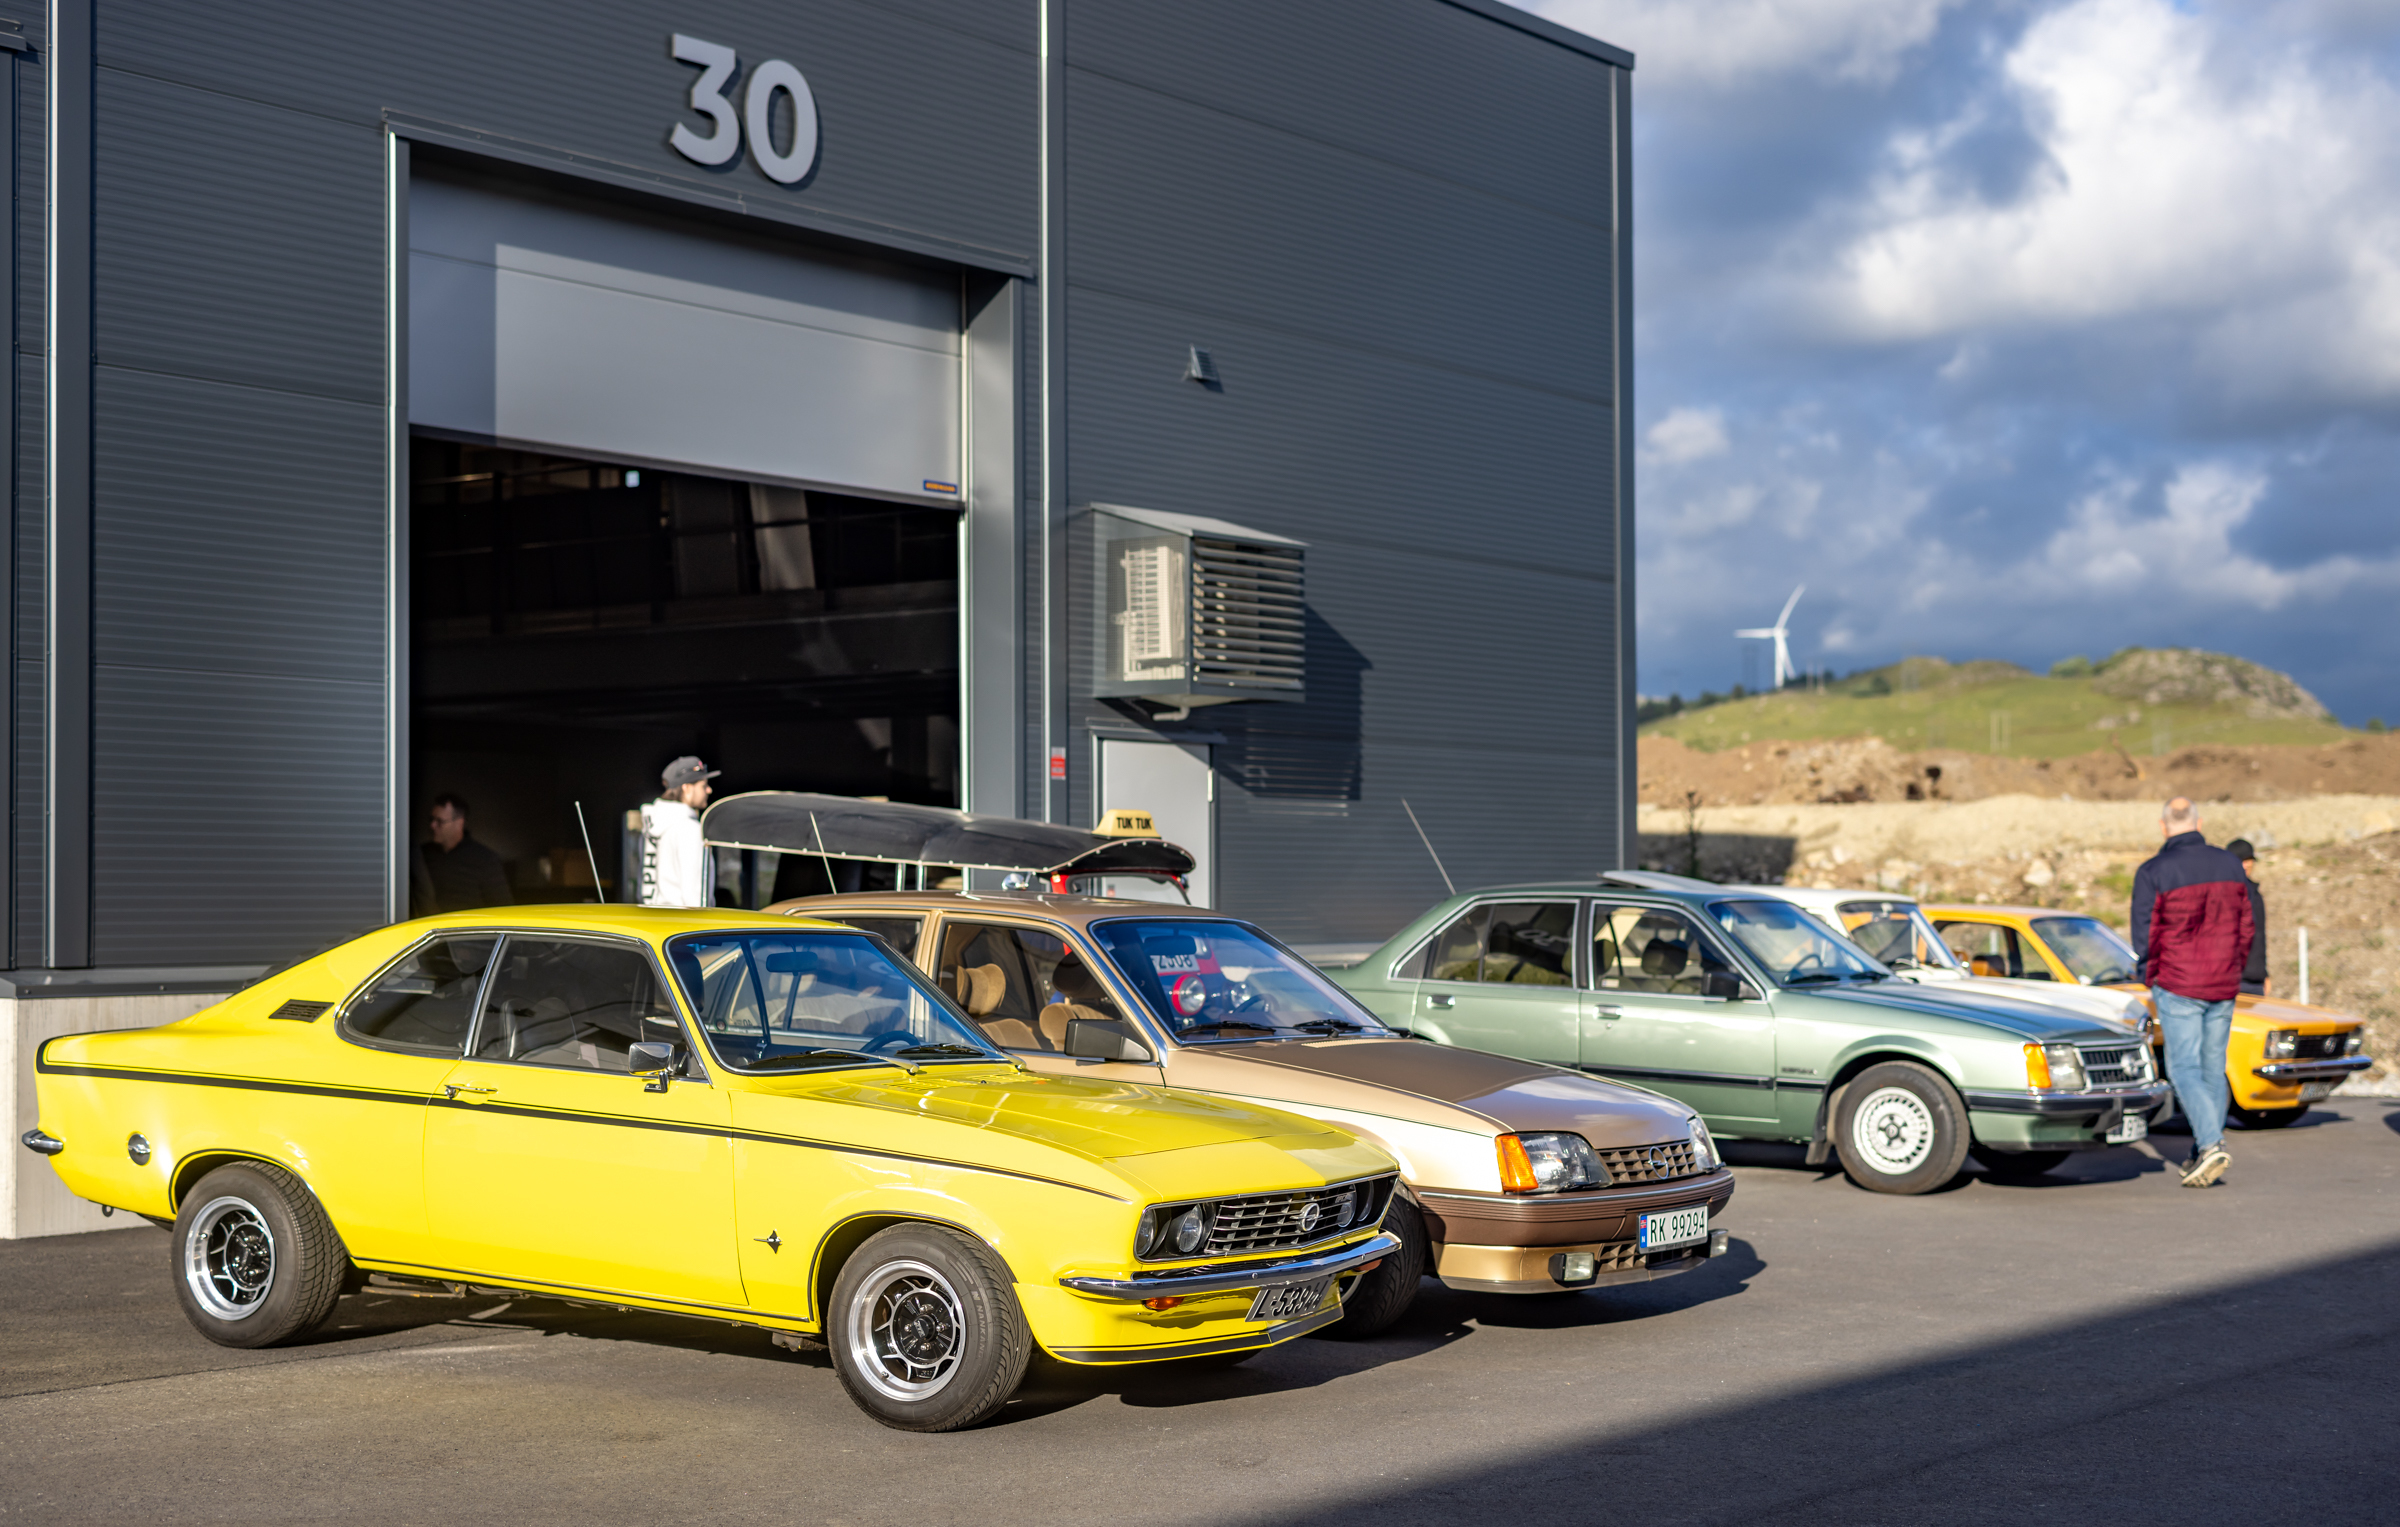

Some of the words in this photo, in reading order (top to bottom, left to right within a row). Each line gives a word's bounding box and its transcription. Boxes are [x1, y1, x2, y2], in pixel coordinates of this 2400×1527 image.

[669, 33, 817, 184] 30
[1116, 817, 1133, 829] TUK
[1135, 818, 1152, 829] TUK
[1650, 1217, 1666, 1243] RK
[1671, 1211, 1705, 1239] 99294
